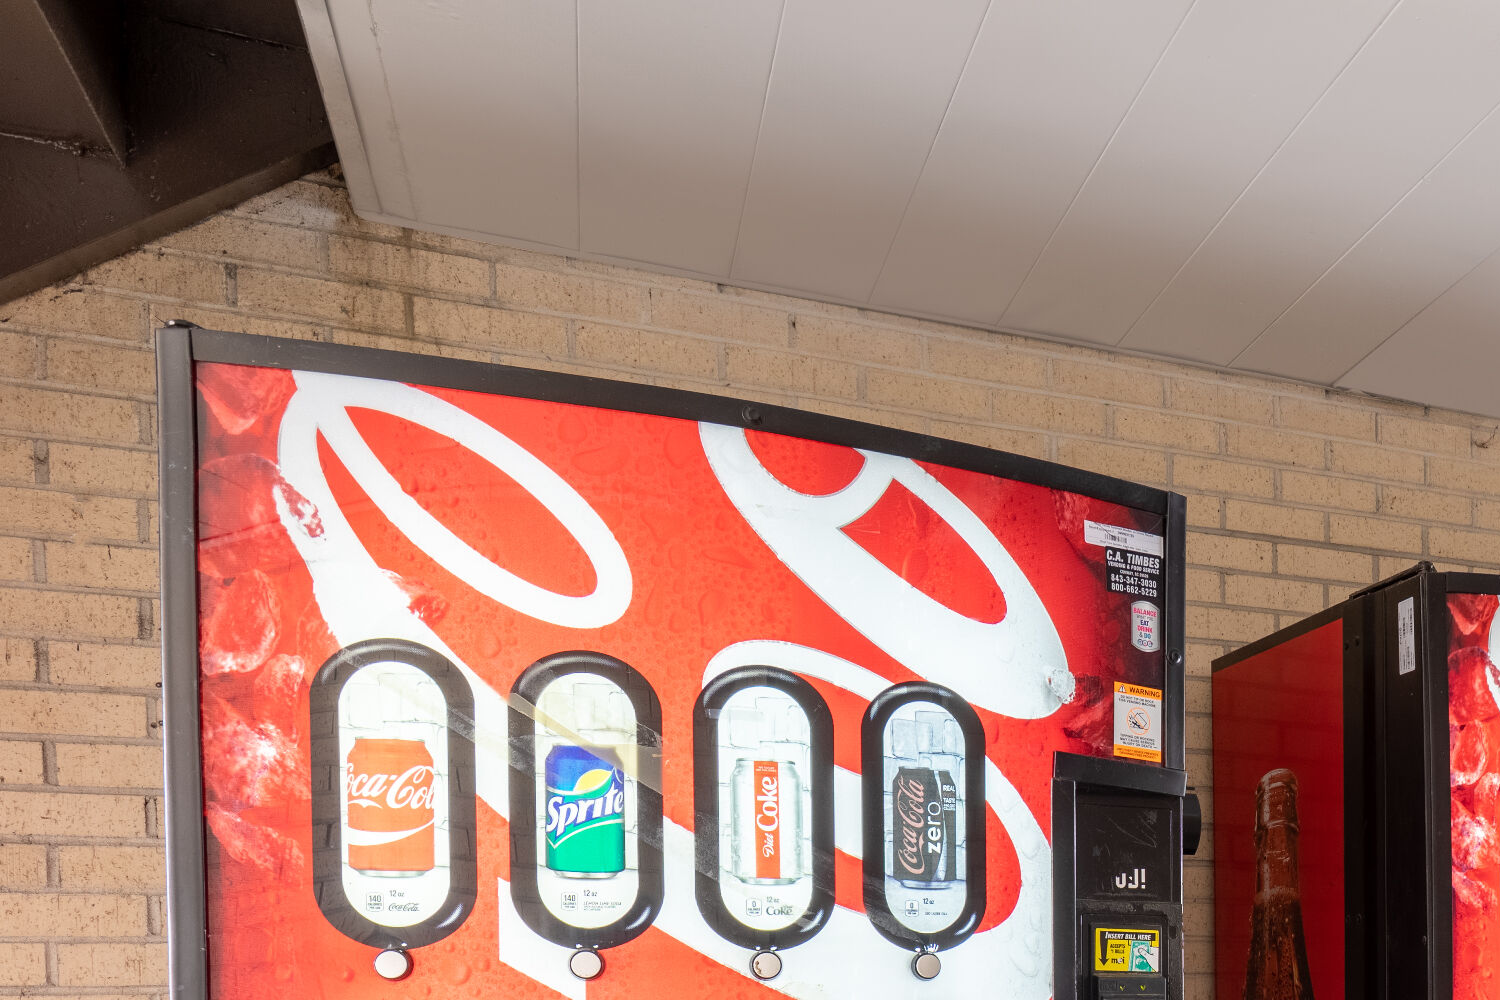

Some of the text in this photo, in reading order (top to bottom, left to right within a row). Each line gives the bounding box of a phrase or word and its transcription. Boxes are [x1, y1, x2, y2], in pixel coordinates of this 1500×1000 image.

[1106, 549, 1160, 569] C.A. TIMBES
[1107, 561, 1126, 569] VENDING
[1131, 564, 1143, 572] FOOD
[1142, 566, 1160, 575] SERVICE
[1110, 573, 1157, 588] 843-347-3030
[1133, 607, 1157, 617] BALANCE
[1137, 625, 1153, 634] DRINK
[1129, 686, 1161, 698] WARNING
[942, 784, 956, 792] REAL
[546, 781, 624, 840] Sprite
[756, 776, 778, 832] Coke
[897, 774, 925, 875] Coca-Cola
[927, 801, 941, 854] zero
[762, 832, 775, 858] Diet
[564, 894, 576, 902] 140
[388, 902, 420, 912] Coca-Cola
[1105, 931, 1152, 941] INSERT BILL HERE
